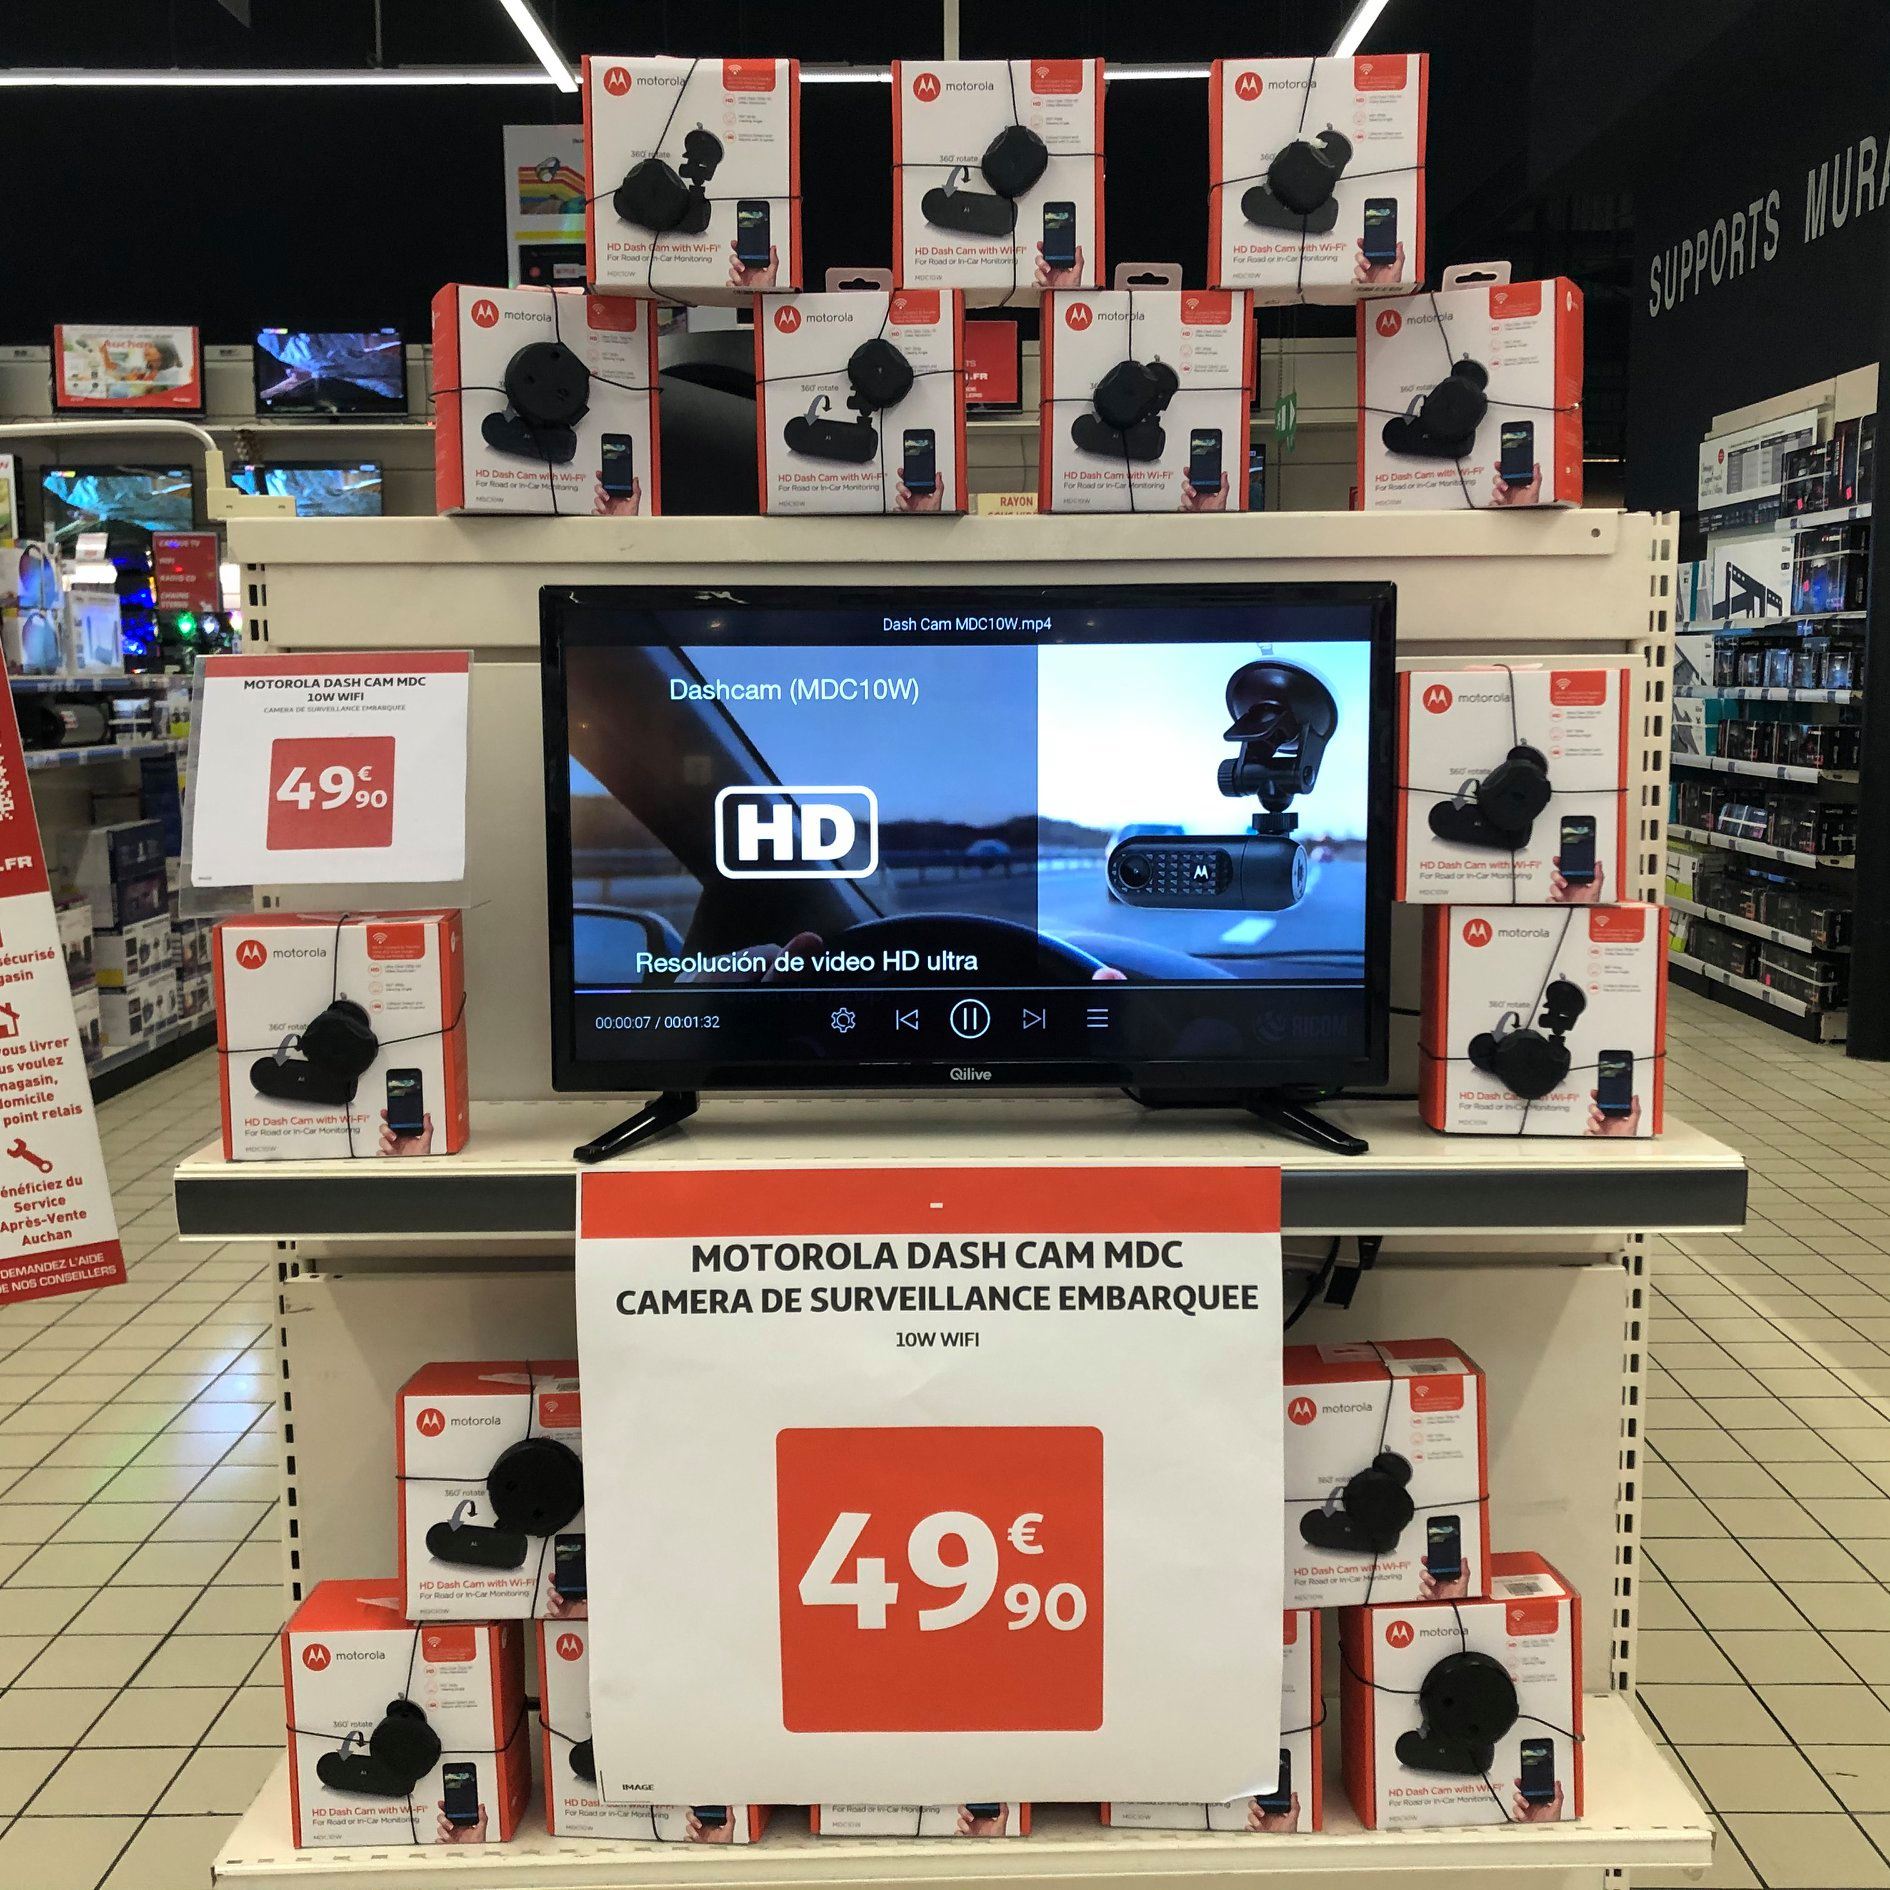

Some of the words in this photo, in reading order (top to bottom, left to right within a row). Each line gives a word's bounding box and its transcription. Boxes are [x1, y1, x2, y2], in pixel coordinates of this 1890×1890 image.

[637, 76, 686, 87] motorola
[946, 81, 994, 91] motorola
[956, 155, 978, 163] rotate
[607, 243, 621, 252] HD
[624, 243, 646, 252] Dash
[672, 243, 692, 252] with
[914, 247, 928, 255] HD
[931, 247, 953, 255] Dash
[955, 246, 976, 255] Cam
[978, 246, 998, 255] with
[1233, 245, 1247, 254] HD
[1250, 244, 1272, 253] Dash
[1274, 244, 1296, 253] Cam
[1650, 189, 1780, 317] SUPPORTS
[504, 310, 552, 323] motorola
[806, 312, 854, 323] motorola
[1097, 311, 1145, 321] motorola
[817, 384, 839, 392] rotate
[475, 469, 489, 478] HD
[491, 470, 513, 479] Dash
[515, 471, 536, 480] Cam
[778, 473, 792, 482] HD
[794, 473, 816, 482] Dash
[818, 473, 838, 482] Cam
[840, 473, 860, 482] with
[1063, 471, 1077, 479] HD
[1079, 471, 1101, 479] Dash
[1103, 471, 1124, 479] Cam
[1375, 472, 1389, 483] HD
[1391, 471, 1413, 481] Dash
[1415, 470, 1435, 479] Cam
[1437, 468, 1456, 478] with
[778, 484, 790, 492] For
[1000, 496, 1033, 506] RAYON
[883, 617, 917, 631] Dash
[920, 617, 952, 631] Cam
[955, 617, 1052, 635] MDC10W.mp4
[244, 679, 320, 689] MOTOROLA
[324, 678, 361, 688] DASH
[364, 677, 393, 687] CAM
[397, 677, 426, 686] MDC
[670, 678, 781, 701] Dashcam
[790, 677, 919, 705] (MDC10W)
[308, 692, 334, 702] 10W
[337, 692, 364, 701] WIFI
[1458, 693, 1512, 703] motorola
[276, 765, 355, 810] 49
[355, 790, 387, 808] 90
[736, 803, 857, 863] HD
[1419, 861, 1435, 869] HD
[1437, 861, 1461, 869] Dash
[1464, 861, 1487, 869] Cam
[1489, 861, 1510, 869] with
[1498, 928, 1550, 938] motorola
[273, 948, 327, 959] motorola
[636, 950, 766, 974] Resolución
[774, 951, 803, 972] de
[811, 951, 875, 971] video
[883, 950, 919, 971] HD
[927, 950, 979, 971] ultra
[595, 1016, 651, 1029] 00:00:07
[664, 1015, 720, 1028] 00:01:32
[0, 1044, 27, 1057] ous
[29, 1037, 69, 1052] livrer
[17, 1056, 63, 1071] voulez
[950, 1067, 992, 1081] Qilive
[1459, 1092, 1474, 1100] HD
[1477, 1092, 1500, 1100] Dash
[3, 1111, 39, 1128] point
[42, 1103, 83, 1120] relais
[244, 1118, 260, 1127] HD
[263, 1117, 287, 1126] Dash
[290, 1116, 313, 1126] Cam
[316, 1116, 338, 1125] with
[66, 1175, 83, 1188] du
[13, 1196, 66, 1213] Service
[0, 1210, 87, 1233] Après-Vente
[22, 1229, 72, 1246] Auchan
[691, 1241, 899, 1273] MOTOROLA
[907, 1240, 1006, 1269] DASH
[1015, 1240, 1094, 1269] CAM
[1104, 1240, 1184, 1269] MDC
[0, 1259, 67, 1279] DEMANDEZ
[69, 1252, 105, 1268] L'AIDE
[0, 1283, 9, 1294] E
[11, 1278, 37, 1291] NOS
[39, 1264, 117, 1287] CONSEILLERS
[615, 1287, 754, 1315] CAMERA
[761, 1287, 802, 1313] DE
[810, 1285, 1051, 1312] SURVEILLANCE
[1059, 1284, 1259, 1316] EMBARQUEE
[896, 1331, 936, 1347] 10W
[940, 1331, 980, 1347] WIFI
[1322, 1402, 1373, 1414] motorola
[451, 1415, 501, 1426] motorola
[462, 1489, 485, 1497] rotate
[798, 1510, 1000, 1632] 49
[1293, 1567, 1308, 1576] HD
[1310, 1565, 1333, 1575] Dash
[1336, 1564, 1358, 1574] Cam
[419, 1581, 434, 1590] HD
[436, 1580, 460, 1590] Dash
[462, 1579, 484, 1589] Cam
[487, 1579, 507, 1588] with
[433, 1591, 454, 1599] Road
[1003, 1583, 1087, 1632] 90
[336, 1650, 386, 1661] motorola
[350, 1720, 373, 1728] rotate
[622, 1783, 655, 1791] IMAGE
[1388, 1787, 1403, 1797] HD
[1405, 1786, 1428, 1796] Dash
[1430, 1785, 1452, 1795] Cam
[1454, 1784, 1474, 1793] with
[564, 1799, 579, 1807] HD
[312, 1808, 326, 1817] HD
[329, 1807, 352, 1816] Dash
[354, 1806, 376, 1815] Cam
[378, 1806, 398, 1815] with
